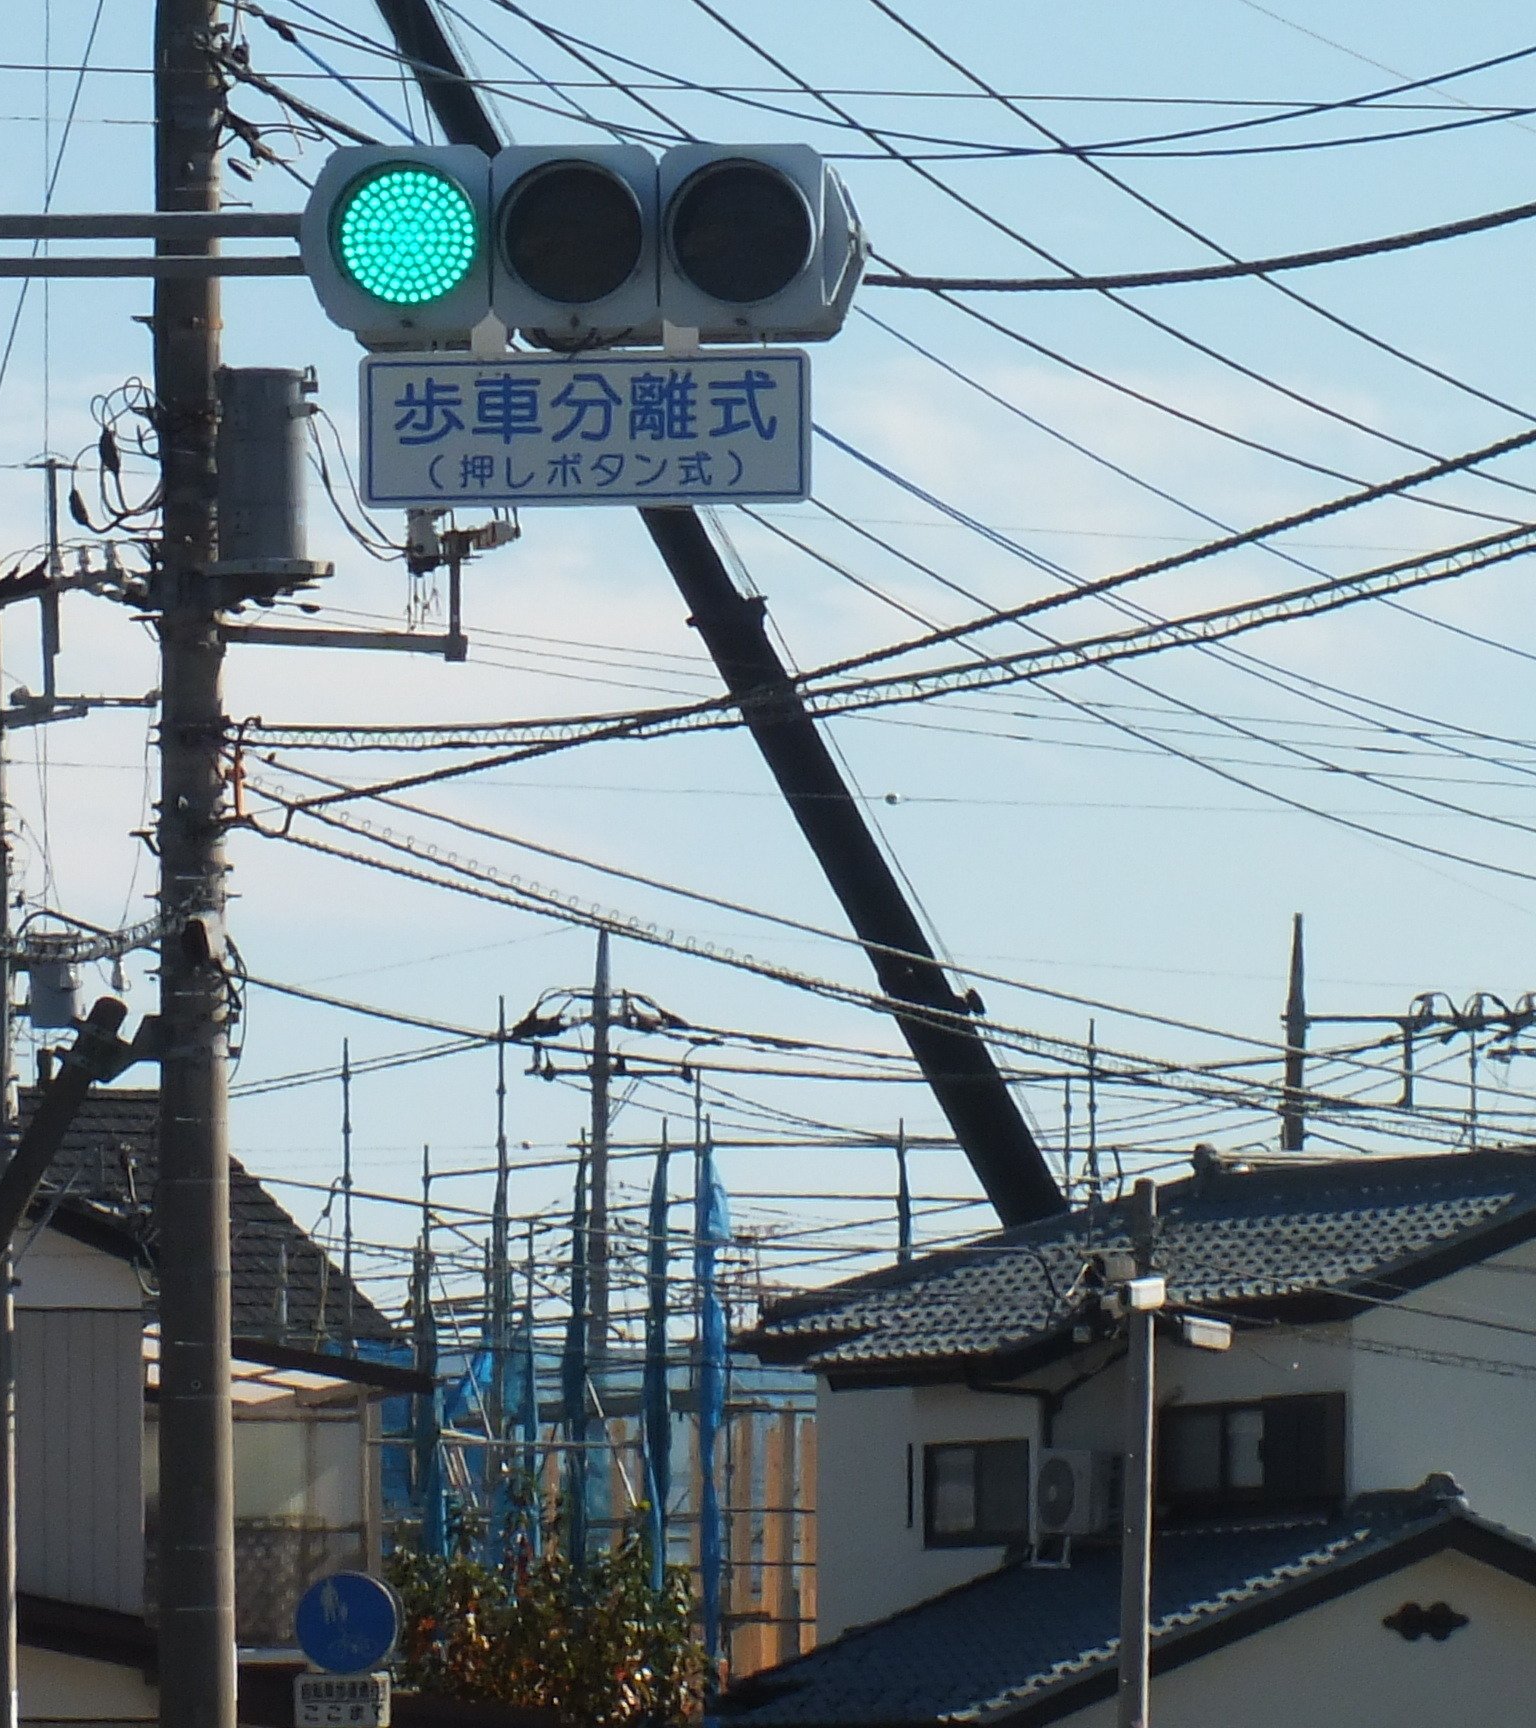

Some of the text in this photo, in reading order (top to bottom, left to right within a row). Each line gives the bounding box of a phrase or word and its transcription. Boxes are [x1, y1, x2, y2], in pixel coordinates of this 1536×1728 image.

[394, 369, 778, 445] 歩車分離式
[428, 450, 744, 489] （押しボタン式）
